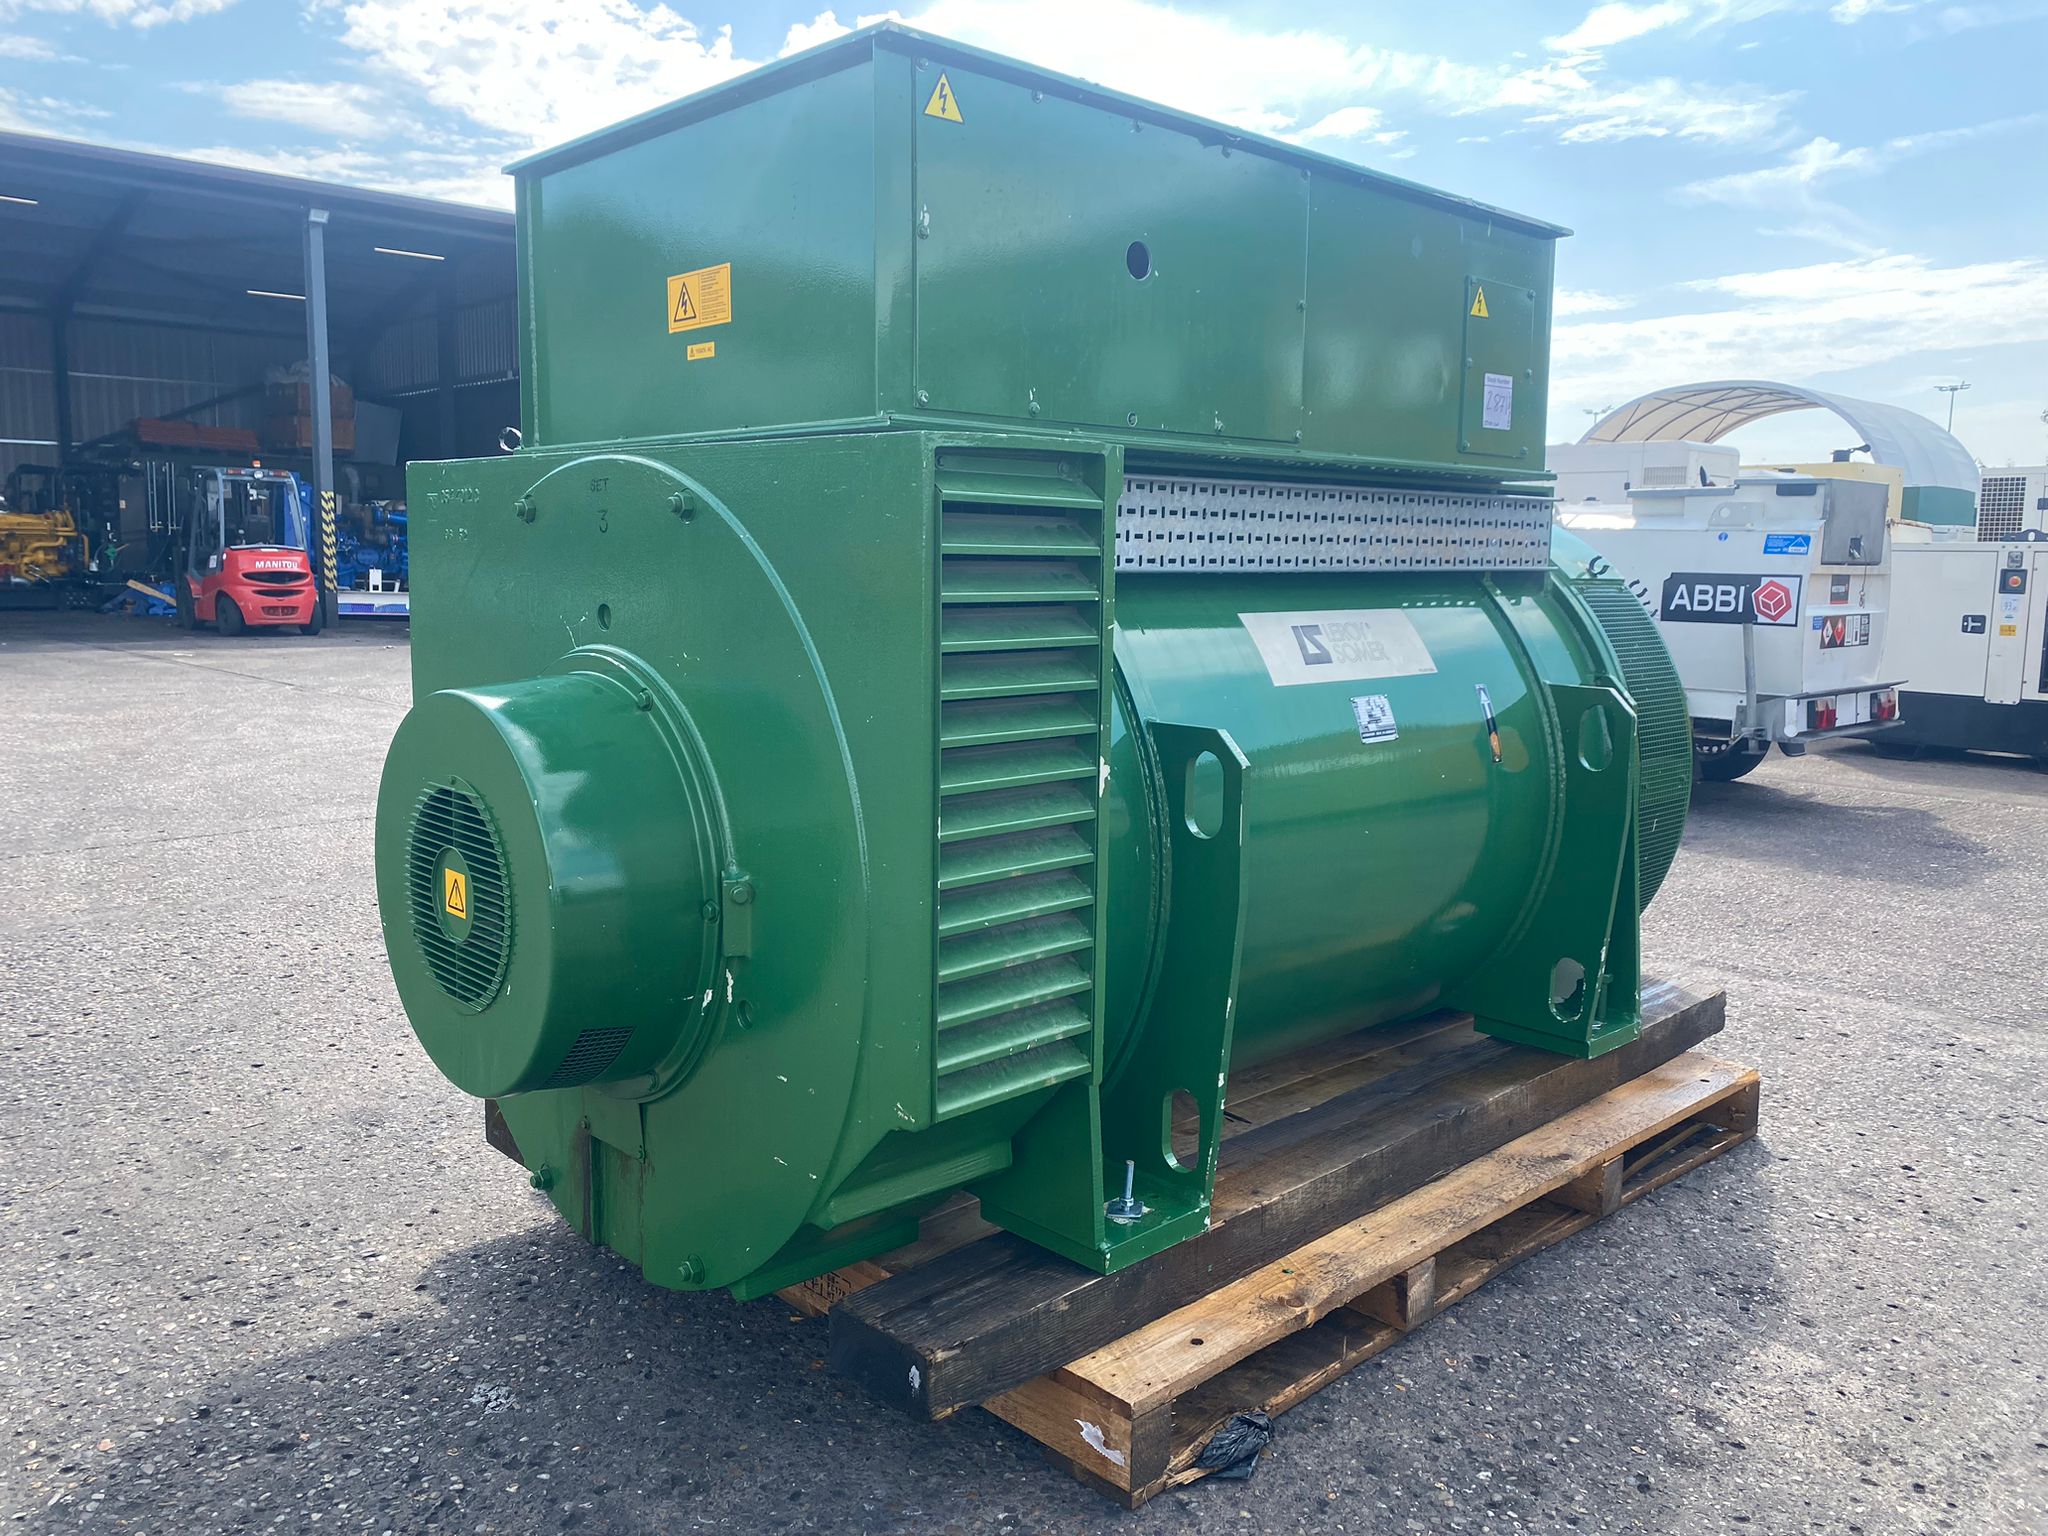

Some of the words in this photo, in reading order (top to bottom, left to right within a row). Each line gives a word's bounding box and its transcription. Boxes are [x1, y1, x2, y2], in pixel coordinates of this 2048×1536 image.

[597, 509, 609, 533] 3
[255, 560, 298, 569] MANITOU
[1669, 583, 1745, 613] ABBI
[1321, 622, 1369, 642] LEROY
[1332, 641, 1390, 664] SOMER
